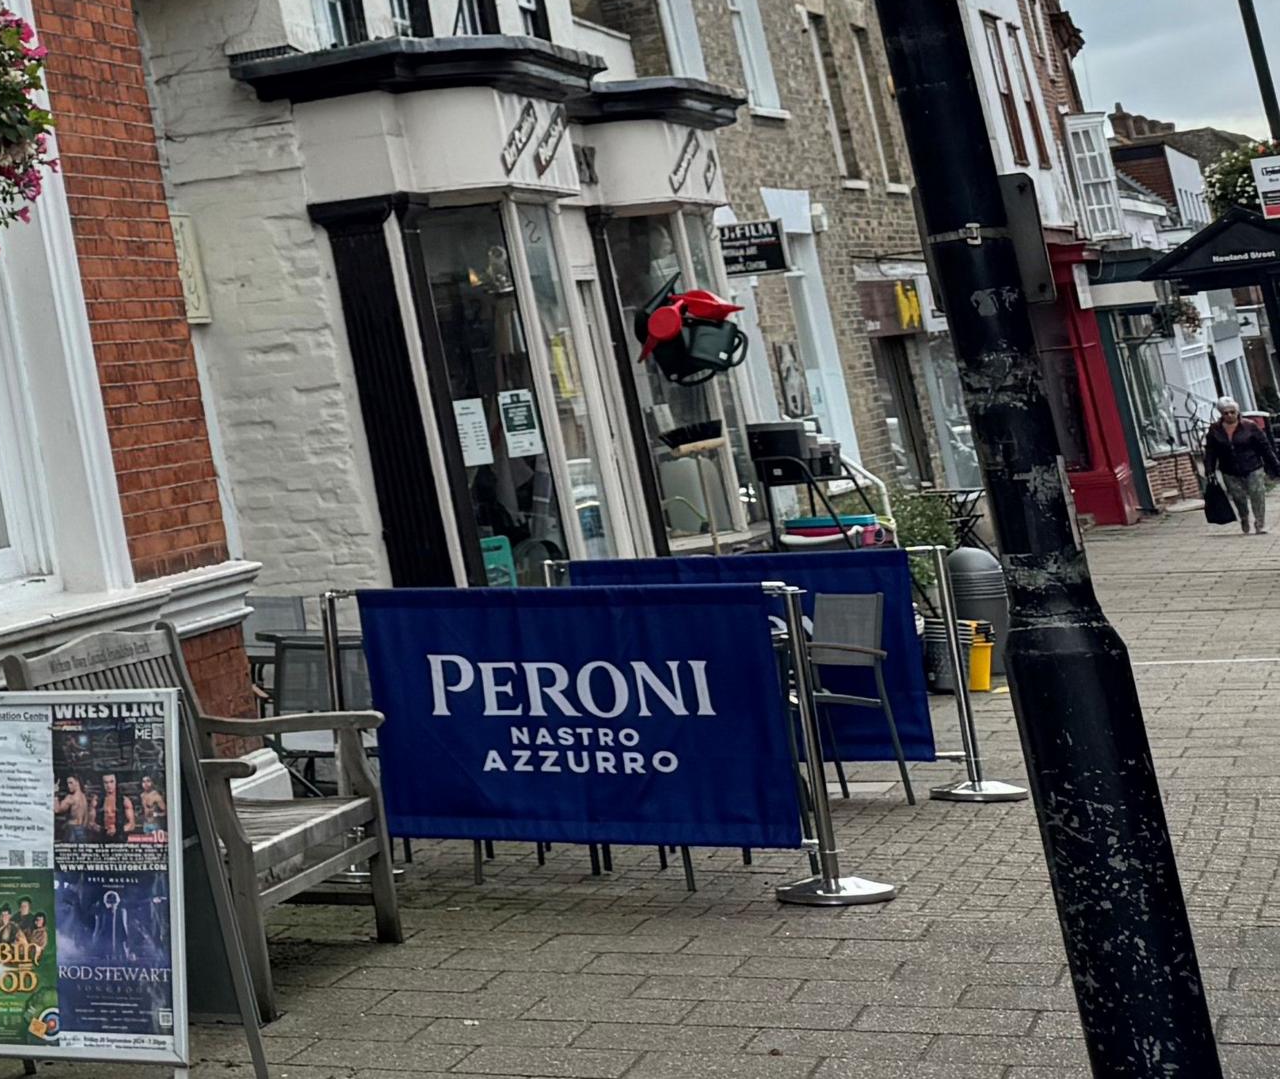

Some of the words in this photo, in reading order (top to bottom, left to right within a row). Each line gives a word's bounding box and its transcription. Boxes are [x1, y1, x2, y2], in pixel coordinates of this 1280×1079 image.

[1213, 252, 1249, 263] Newland
[1250, 250, 1276, 260] Street
[426, 654, 716, 718] PERONI
[23, 712, 49, 721] Centre
[135, 729, 152, 740] ME
[510, 726, 639, 747] NASTRO
[483, 749, 678, 774] AZZURRO
[59, 965, 93, 980] ROD
[94, 966, 171, 982] STEWART
